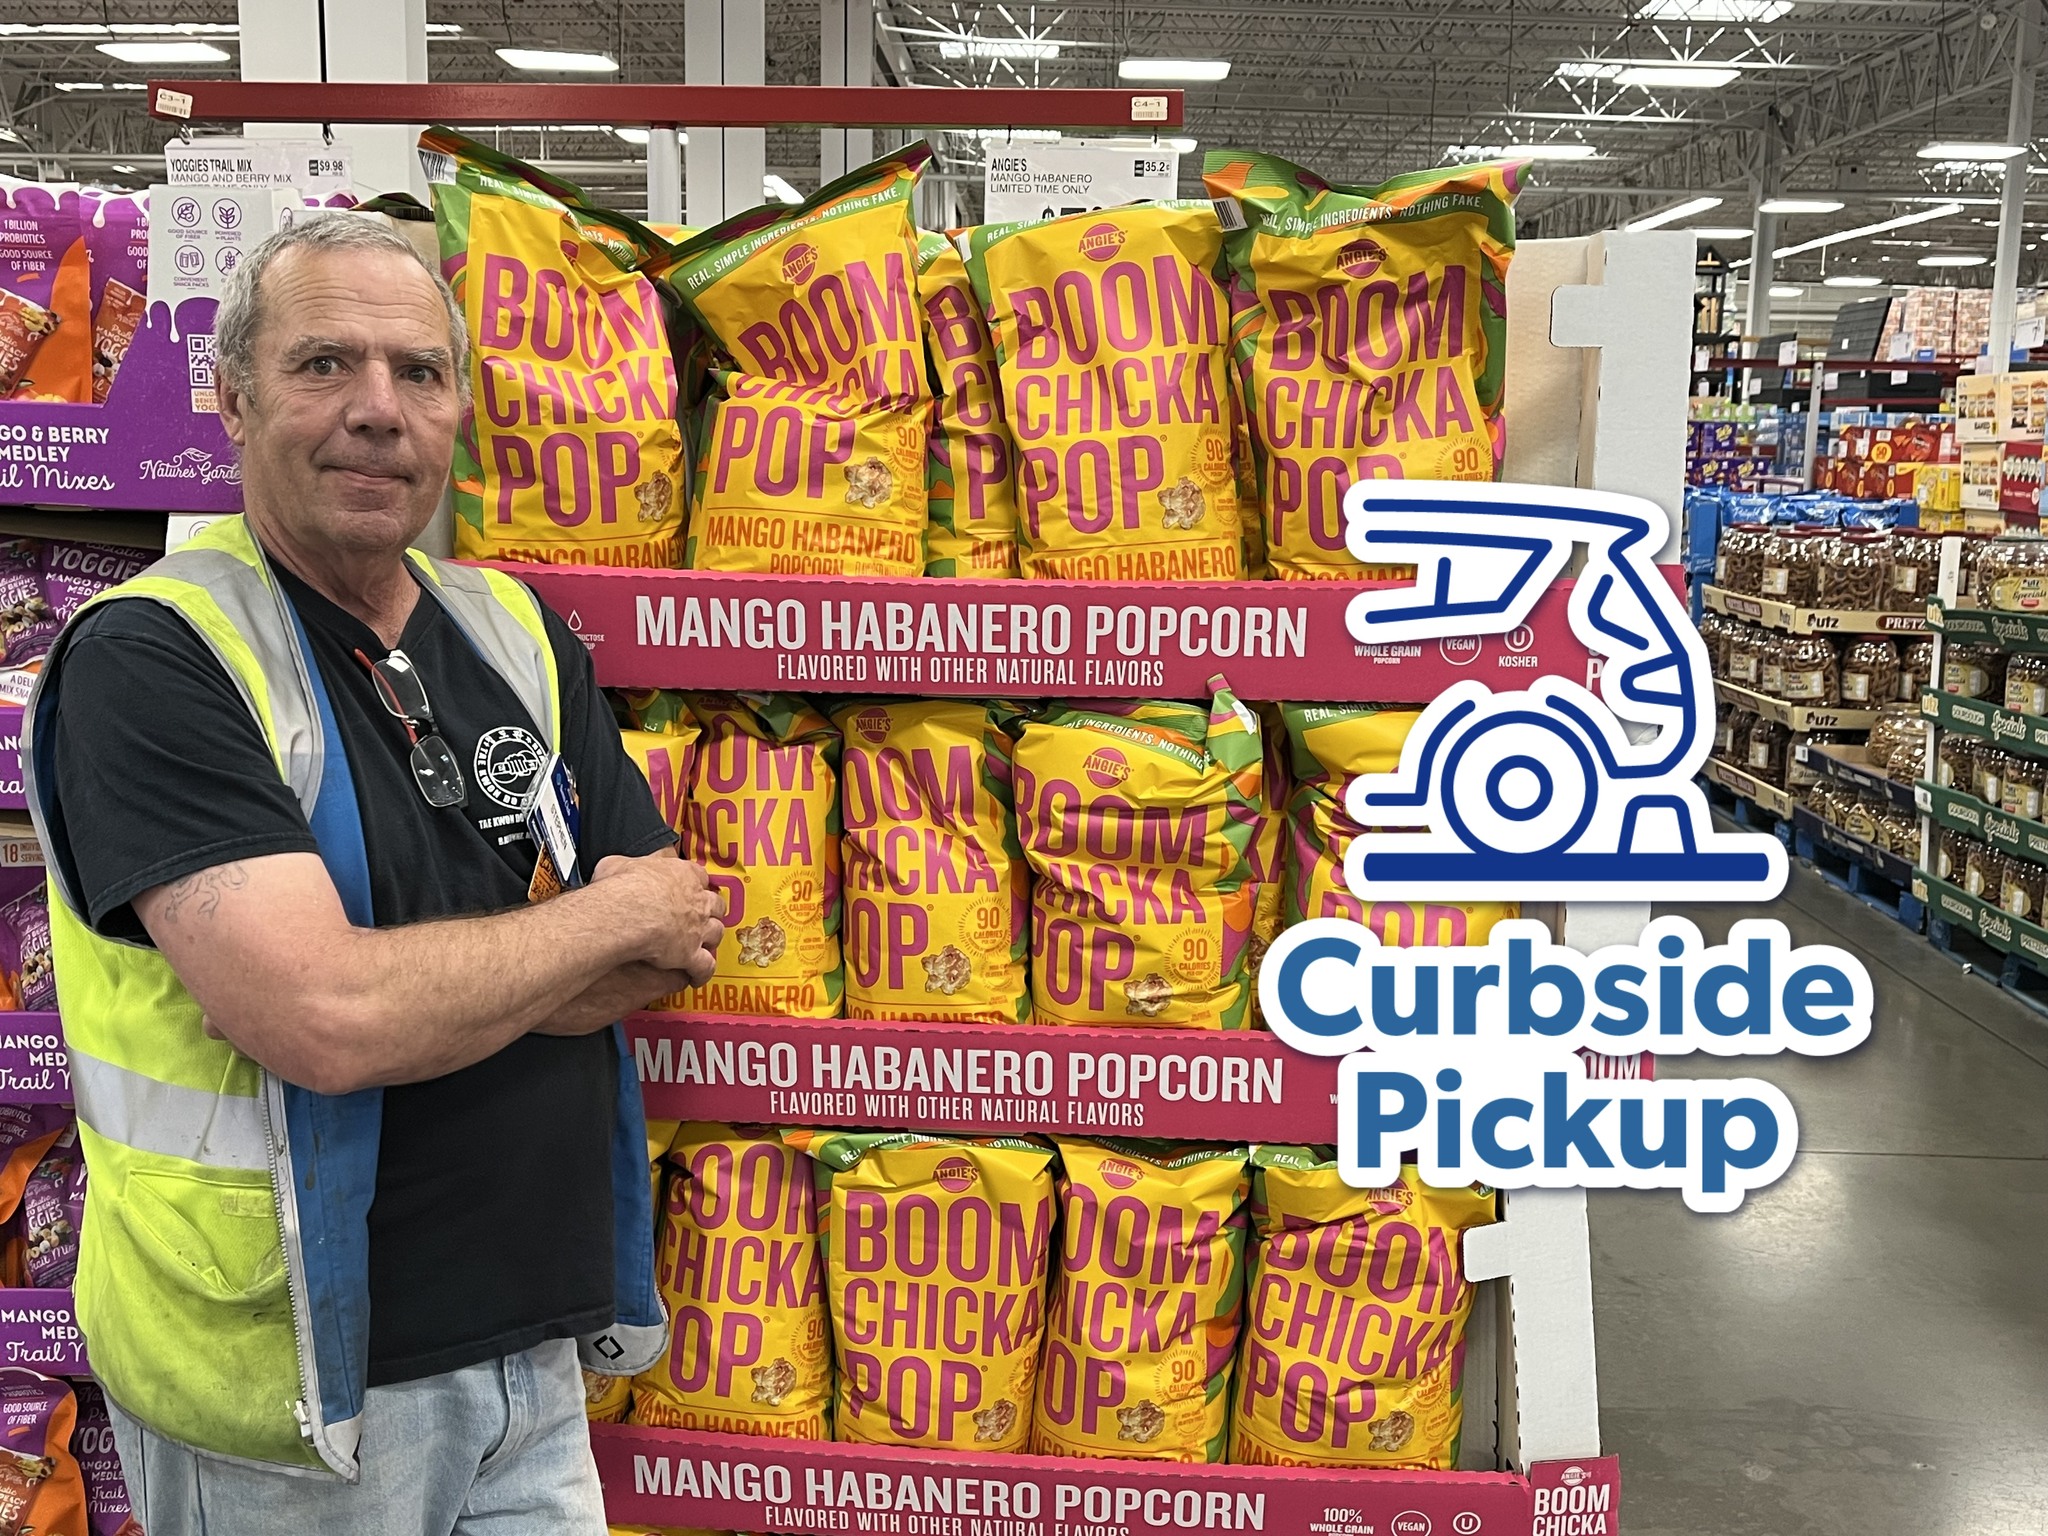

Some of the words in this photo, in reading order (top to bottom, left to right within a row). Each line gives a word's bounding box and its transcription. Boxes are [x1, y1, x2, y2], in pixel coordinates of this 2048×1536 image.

[1133, 100, 1162, 108] C4-1
[170, 159, 208, 172] YOGGIES
[210, 159, 234, 172] TRAIL
[237, 160, 252, 172] MIX
[319, 161, 343, 171] $9.98
[991, 158, 1027, 172] ANGIE'S
[171, 174, 210, 183] MANGO
[212, 174, 234, 182] AND
[236, 174, 270, 183] BERRY
[274, 175, 292, 183] MIX
[990, 173, 1029, 183] MANGO
[1033, 174, 1092, 184] HABANERO
[990, 184, 1031, 194] LIMITED
[1034, 185, 1059, 194] TIME
[1062, 185, 1090, 195] ONLY
[1400, 197, 1449, 218] NOTHING
[687, 264, 714, 290] REAL,
[714, 245, 750, 273] SIMPLE
[822, 198, 870, 219] NOTHING
[872, 186, 901, 207] FAKE.
[1078, 230, 1128, 254] ANGIE'S
[11, 261, 21, 271] OF
[23, 262, 46, 271] FIBER
[22, 250, 53, 260] SOURCE
[782, 246, 818, 281] ANGIE'S
[480, 253, 671, 370] BOOM
[738, 252, 916, 387] BOOM
[1009, 254, 1219, 369] BOOM
[1268, 265, 1466, 374] BOOM
[1016, 353, 1220, 440] CHICKA
[1265, 366, 1474, 450] CHICKA
[31, 427, 43, 442] &
[48, 427, 110, 444] BERRY
[898, 425, 918, 448] 90
[714, 405, 857, 499] POP
[1206, 438, 1224, 462] 90
[1452, 447, 1479, 472] 90
[25, 464, 115, 490] Mixes
[139, 459, 197, 481] Nature's
[491, 431, 641, 528] POP
[1022, 434, 1165, 539] POP
[706, 515, 786, 548] MANGO
[791, 520, 917, 564] HABANERO
[1116, 545, 1238, 581] HABANERO
[46, 572, 91, 587] MANGO
[635, 595, 807, 649] MANGO
[821, 600, 1071, 656] HABANERO
[1086, 605, 1307, 658] POPCORN
[1354, 645, 1390, 657] WHOLE
[1391, 645, 1421, 658] GRAIN
[1446, 638, 1475, 652] VEGAN
[777, 653, 867, 681] FLAVORED
[876, 657, 922, 683] WITH
[930, 658, 988, 684] OTHER
[996, 658, 1078, 685] NATURAL
[1085, 659, 1164, 687] FLAVORS
[1498, 656, 1538, 668] KOSHER
[1082, 754, 1132, 782] ANGIE'S
[2, 844, 18, 863] 18
[791, 880, 813, 902] 90
[976, 906, 999, 929] 90
[1182, 938, 1208, 961] 90
[692, 983, 815, 1014] HABANERO
[634, 1037, 798, 1088] MANGO
[812, 1043, 1055, 1098] HABANERO
[1068, 1052, 1284, 1105] POPCORN
[770, 1090, 857, 1117] FLAVORED
[865, 1094, 909, 1119] WITH
[917, 1095, 973, 1121] OTHER
[981, 1098, 1060, 1124] NATURAL
[1067, 1100, 1144, 1127] FLAVORS
[1167, 1150, 1211, 1168] NOTHING
[932, 1165, 979, 1182] ANGIE'S
[1098, 1160, 1147, 1182] ANGIE'S
[1364, 1188, 1415, 1206] ANGIE'S
[844, 1190, 1050, 1288] BOOM
[1063, 1183, 1220, 1286] OOM
[1265, 1213, 1463, 1315] BOOM
[1, 1309, 70, 1323] MANGO
[844, 1278, 1039, 1358] CHICKA
[1254, 1274, 1456, 1380] CHICKA
[6, 1342, 66, 1362] Trail
[1171, 1359, 1195, 1382] 90
[844, 1349, 982, 1442] POP
[1242, 1338, 1377, 1448] POP
[3, 1402, 21, 1414] GOOD
[22, 1400, 48, 1413] SOURCE
[7, 1415, 16, 1425] OF
[16, 1414, 36, 1424] FIBER
[92, 1485, 125, 1500] Trail
[633, 1454, 792, 1504] MANGO
[805, 1467, 1041, 1519] HABANERO
[1054, 1484, 1265, 1531] POPCORN
[1533, 1483, 1611, 1517] BOOM
[88, 1500, 131, 1514] Mixes
[1323, 1507, 1363, 1524] 100%
[765, 1505, 850, 1532] FLAVORED
[857, 1512, 901, 1535] WITH
[908, 1514, 962, 1536] OTHER
[1309, 1522, 1343, 1535] WHOLE
[1344, 1523, 1374, 1535] GRAIN
[1397, 1521, 1426, 1533] VEGAN
[1532, 1513, 1607, 1536] CHICKA
